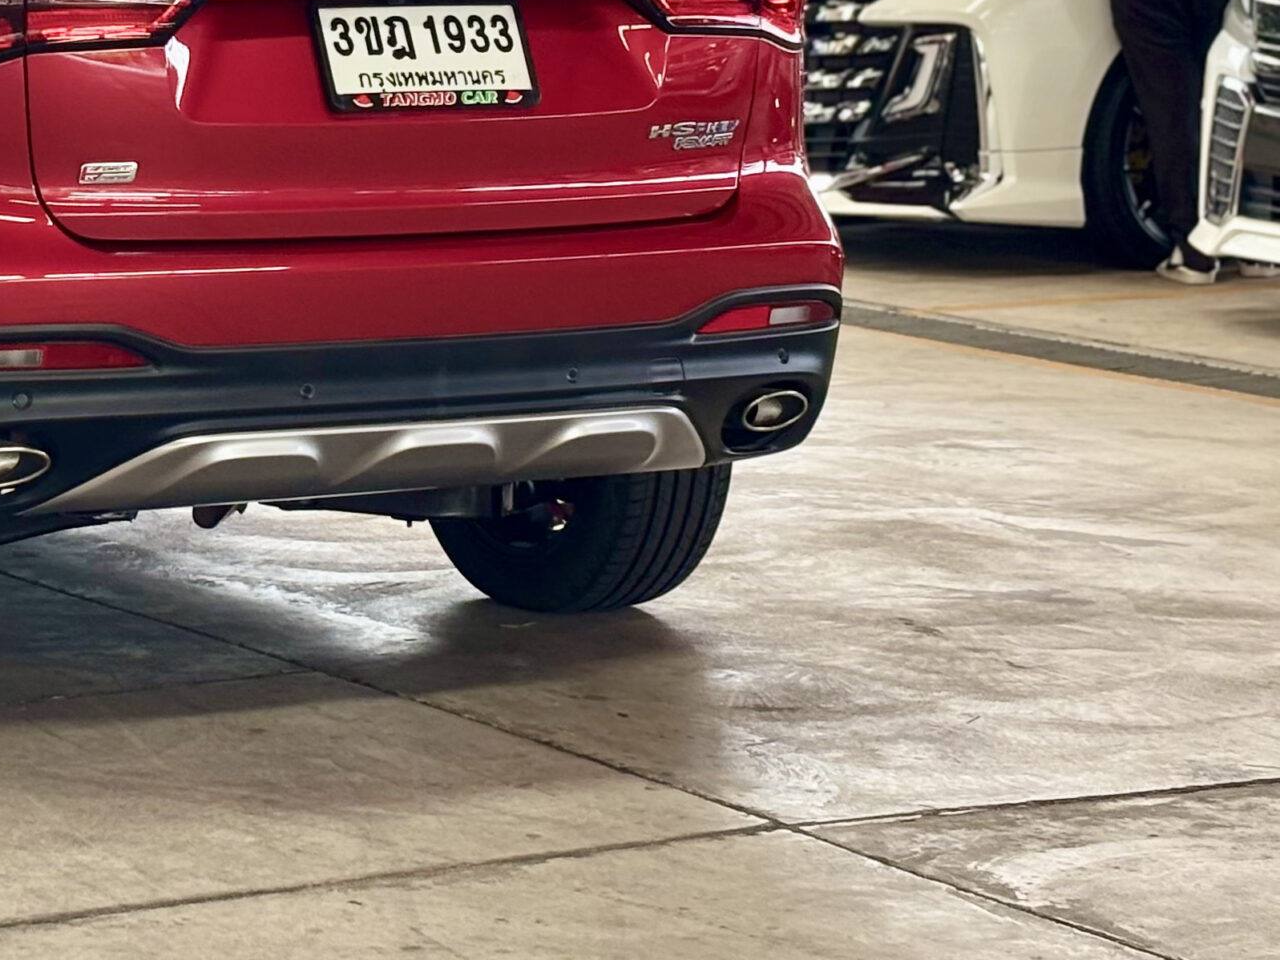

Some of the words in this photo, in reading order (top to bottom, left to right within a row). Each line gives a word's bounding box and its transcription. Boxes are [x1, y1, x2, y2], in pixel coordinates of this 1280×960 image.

[330, 15, 417, 60] 3ขฎ
[423, 14, 514, 54] 1933
[359, 68, 506, 92] กรุงเทพมหานคร
[380, 91, 457, 107] TANGMO
[461, 90, 499, 105] CAR
